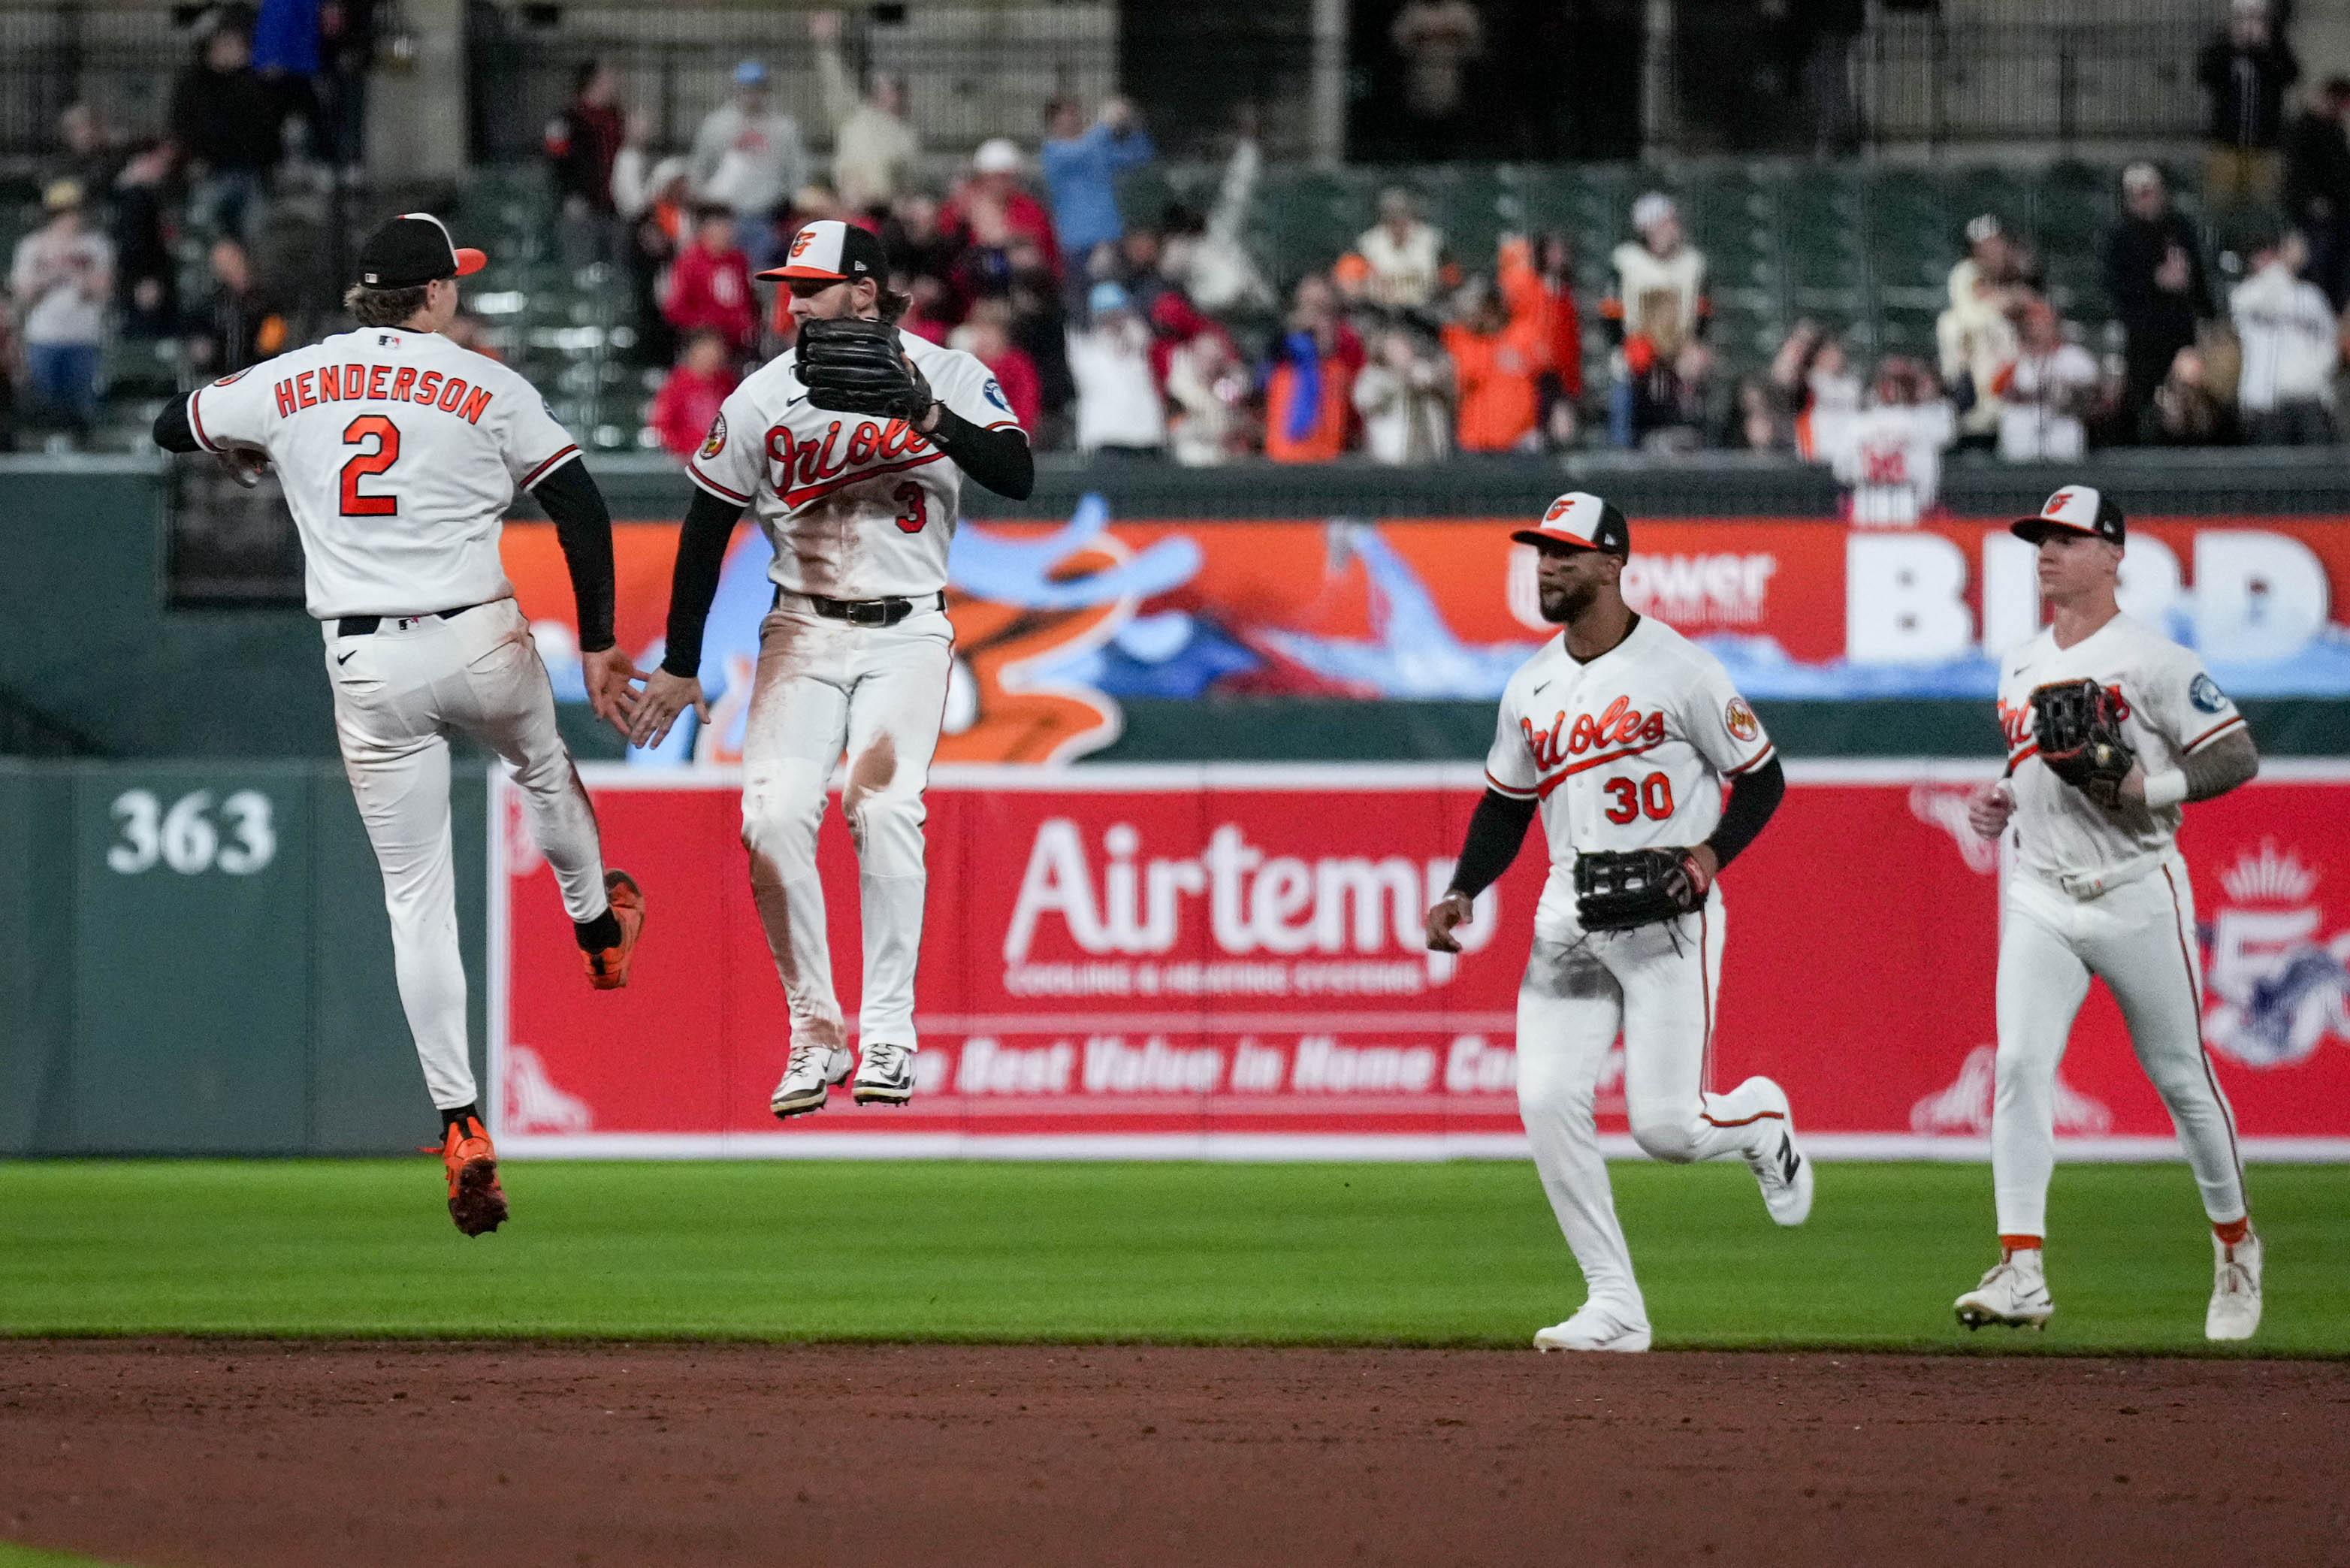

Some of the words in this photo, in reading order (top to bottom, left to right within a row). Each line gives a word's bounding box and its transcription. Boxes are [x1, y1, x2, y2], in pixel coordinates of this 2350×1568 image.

[274, 364, 493, 425] HENDERSON
[340, 414, 400, 516] 2
[765, 418, 932, 497] Oriole
[893, 481, 927, 533] 3
[1620, 551, 1777, 606] ower
[1603, 771, 1675, 825] 30
[107, 789, 276, 875] 363
[1002, 817, 1499, 985] Airtemp
[956, 1037, 1073, 1092] Best
[1083, 1035, 1222, 1093] Value
[1230, 1035, 1282, 1092] in
[1293, 1035, 1435, 1093] Home
